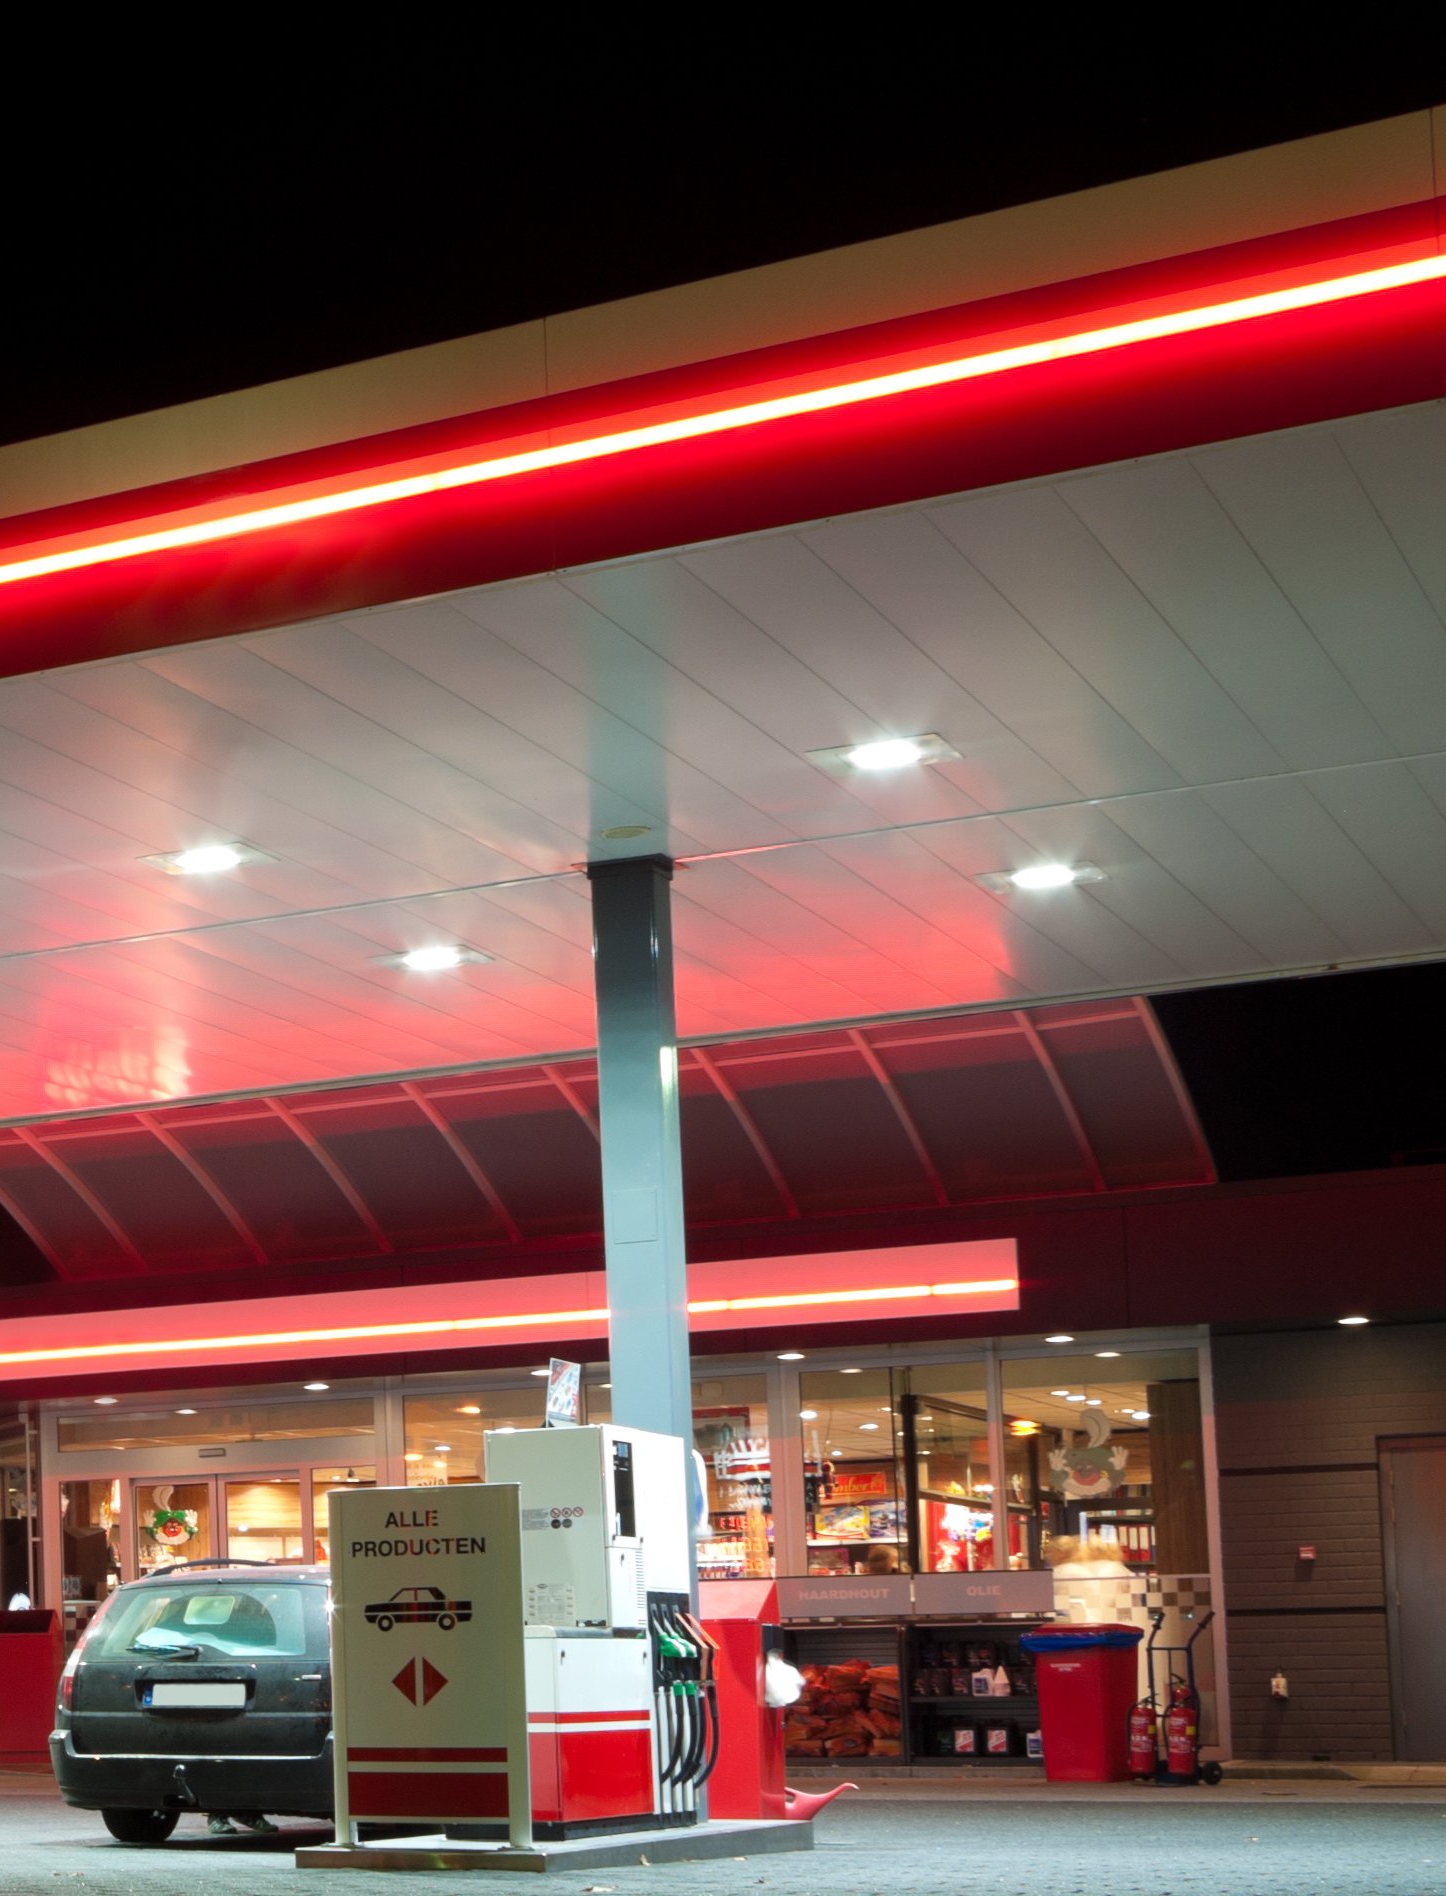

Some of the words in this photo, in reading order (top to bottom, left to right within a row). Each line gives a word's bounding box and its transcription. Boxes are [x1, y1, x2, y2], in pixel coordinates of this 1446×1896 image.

[385, 1509, 439, 1529] ALLE
[351, 1536, 486, 1559] PRODUCTEN
[798, 1587, 891, 1601] HAARDHOUT
[966, 1585, 1002, 1597] OLIE
